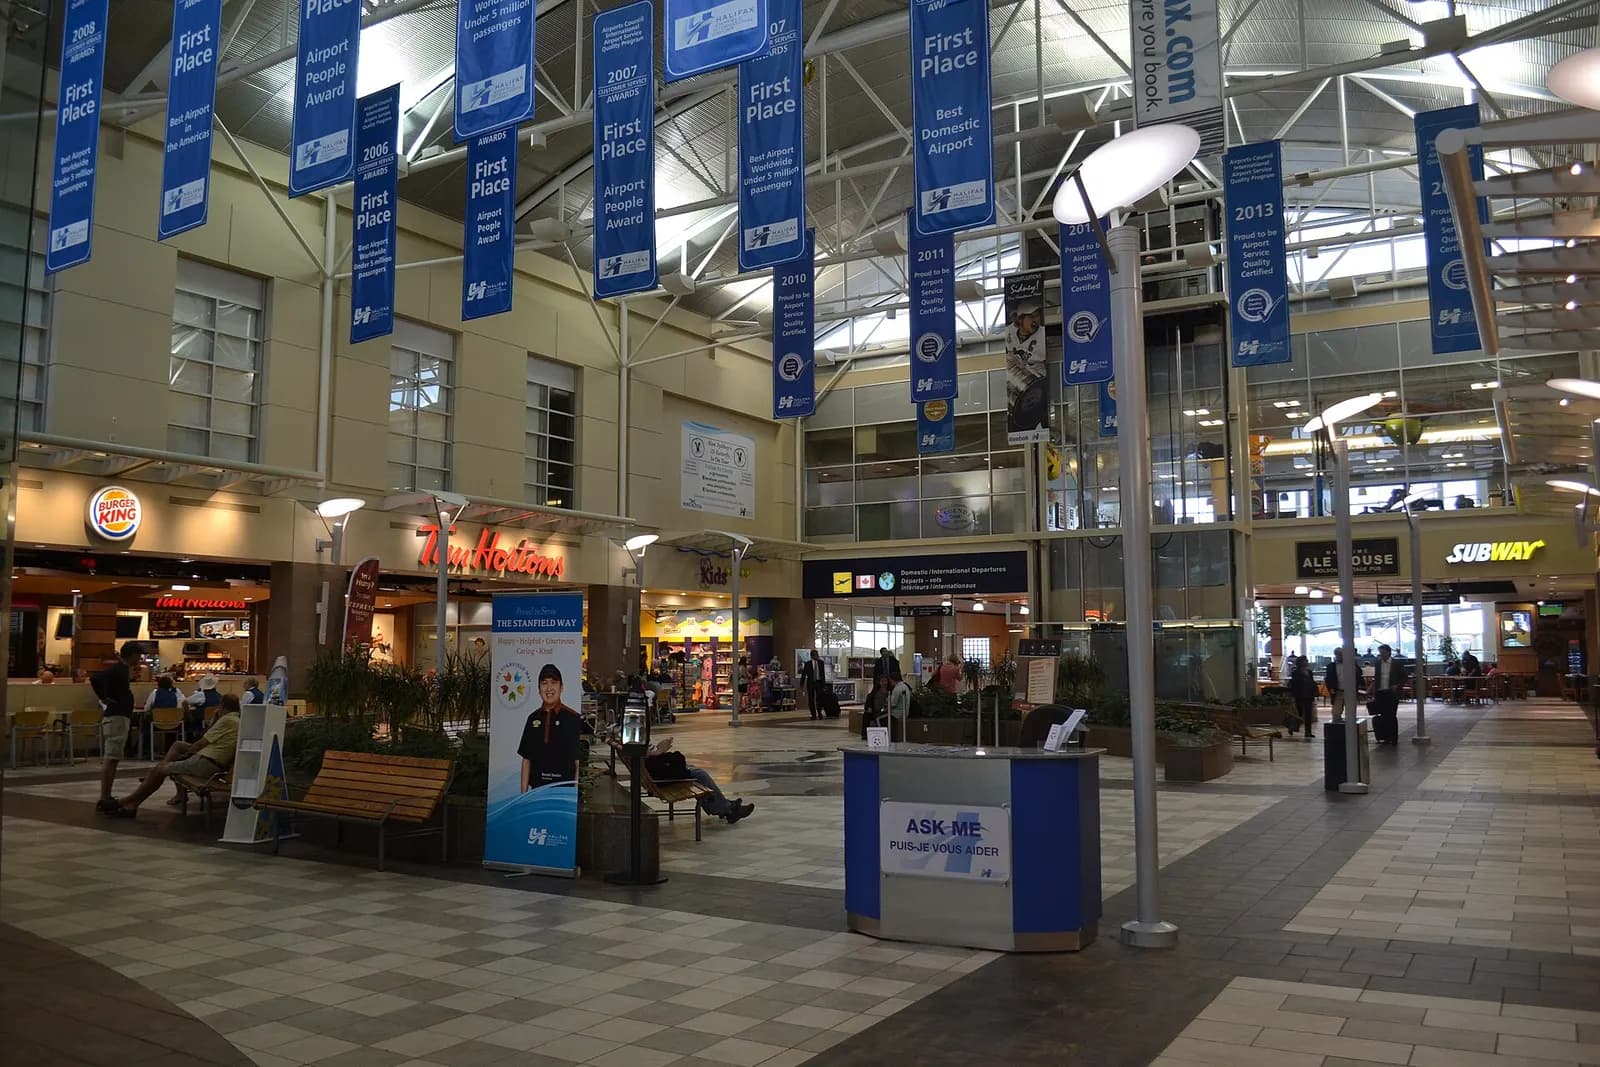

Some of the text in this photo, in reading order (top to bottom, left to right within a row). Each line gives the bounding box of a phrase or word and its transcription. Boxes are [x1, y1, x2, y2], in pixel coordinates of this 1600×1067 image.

[464, 0, 530, 30] Under 5 million
[716, 8, 754, 22] HALIFAX
[72, 21, 95, 43] 2008
[473, 16, 522, 43] passengers
[602, 16, 644, 34] Airports Council
[606, 24, 640, 39] International
[770, 18, 786, 36] 07
[179, 24, 211, 54] First
[602, 36, 644, 53] Quality Program
[604, 30, 642, 46] Airport Service
[774, 32, 796, 45] SERVICE
[924, 26, 974, 56] First
[306, 38, 349, 66] Airport
[174, 48, 213, 77] Place
[920, 50, 978, 78] Place
[1138, 24, 1162, 112] you book.
[306, 62, 346, 86] People
[608, 64, 638, 84] 2007
[66, 78, 94, 105] First
[305, 81, 345, 109] Award
[598, 78, 648, 96] CUSTOMER SERVICE
[750, 76, 791, 103] First
[606, 88, 640, 104] AWARDS
[62, 100, 96, 126] Place
[170, 104, 210, 128] Best Airport
[746, 98, 796, 124] Place
[936, 104, 964, 122] Best
[184, 123, 192, 132] in
[604, 118, 640, 142] First
[922, 117, 980, 141] Domestic
[167, 130, 210, 152] the Americas
[478, 130, 506, 146] AWARDS
[928, 135, 974, 156] Airport
[364, 142, 388, 162] 2006
[602, 138, 646, 160] Place
[749, 146, 794, 164] Best Airport
[363, 166, 388, 180] AWARDS
[476, 156, 508, 180] First
[751, 158, 793, 174] Worldwide
[744, 166, 800, 186] Under 5 million
[472, 178, 510, 199] Place
[604, 179, 646, 198] Airport
[750, 180, 792, 198] passengers
[953, 186, 984, 198] HALIFAX
[360, 190, 388, 212] First
[605, 197, 644, 214] People
[357, 209, 392, 230] Place
[476, 208, 502, 222] Airport
[1235, 203, 1274, 222] 2013
[477, 220, 501, 234] People
[606, 212, 644, 232] Award
[477, 232, 500, 246] Award
[1234, 228, 1278, 241] Proud to be
[1064, 243, 1094, 254] Proud to
[1242, 240, 1270, 250] Airport
[918, 248, 944, 262] 2011
[1072, 252, 1097, 263] Airport
[1242, 250, 1270, 259] Service
[914, 266, 950, 278] Proud to be
[1073, 263, 1098, 273] Service
[1242, 258, 1271, 269] Quality
[782, 273, 807, 286] 2010
[1073, 273, 1098, 284] Quality
[1240, 267, 1274, 278] Certified
[920, 278, 944, 288] Airport
[1071, 282, 1100, 294] Certified
[778, 291, 810, 302] Proud to be
[920, 288, 944, 297] Service
[784, 302, 804, 310] Airport
[920, 297, 944, 306] Quality
[784, 310, 804, 319] Service
[920, 306, 946, 316] Certified
[782, 328, 806, 338] Certified
[784, 320, 804, 329] Quality
[98, 499, 136, 512] BURGER
[98, 508, 136, 525] KING
[472, 528, 564, 577] Hortons
[1445, 540, 1546, 564] SUBWAY
[1303, 554, 1393, 568] ALE OUSE
[496, 619, 577, 628] THE STANFIELD WAY
[906, 818, 982, 838] ASK ME
[890, 840, 1000, 857] PUIS-JE VOUS AIDER
